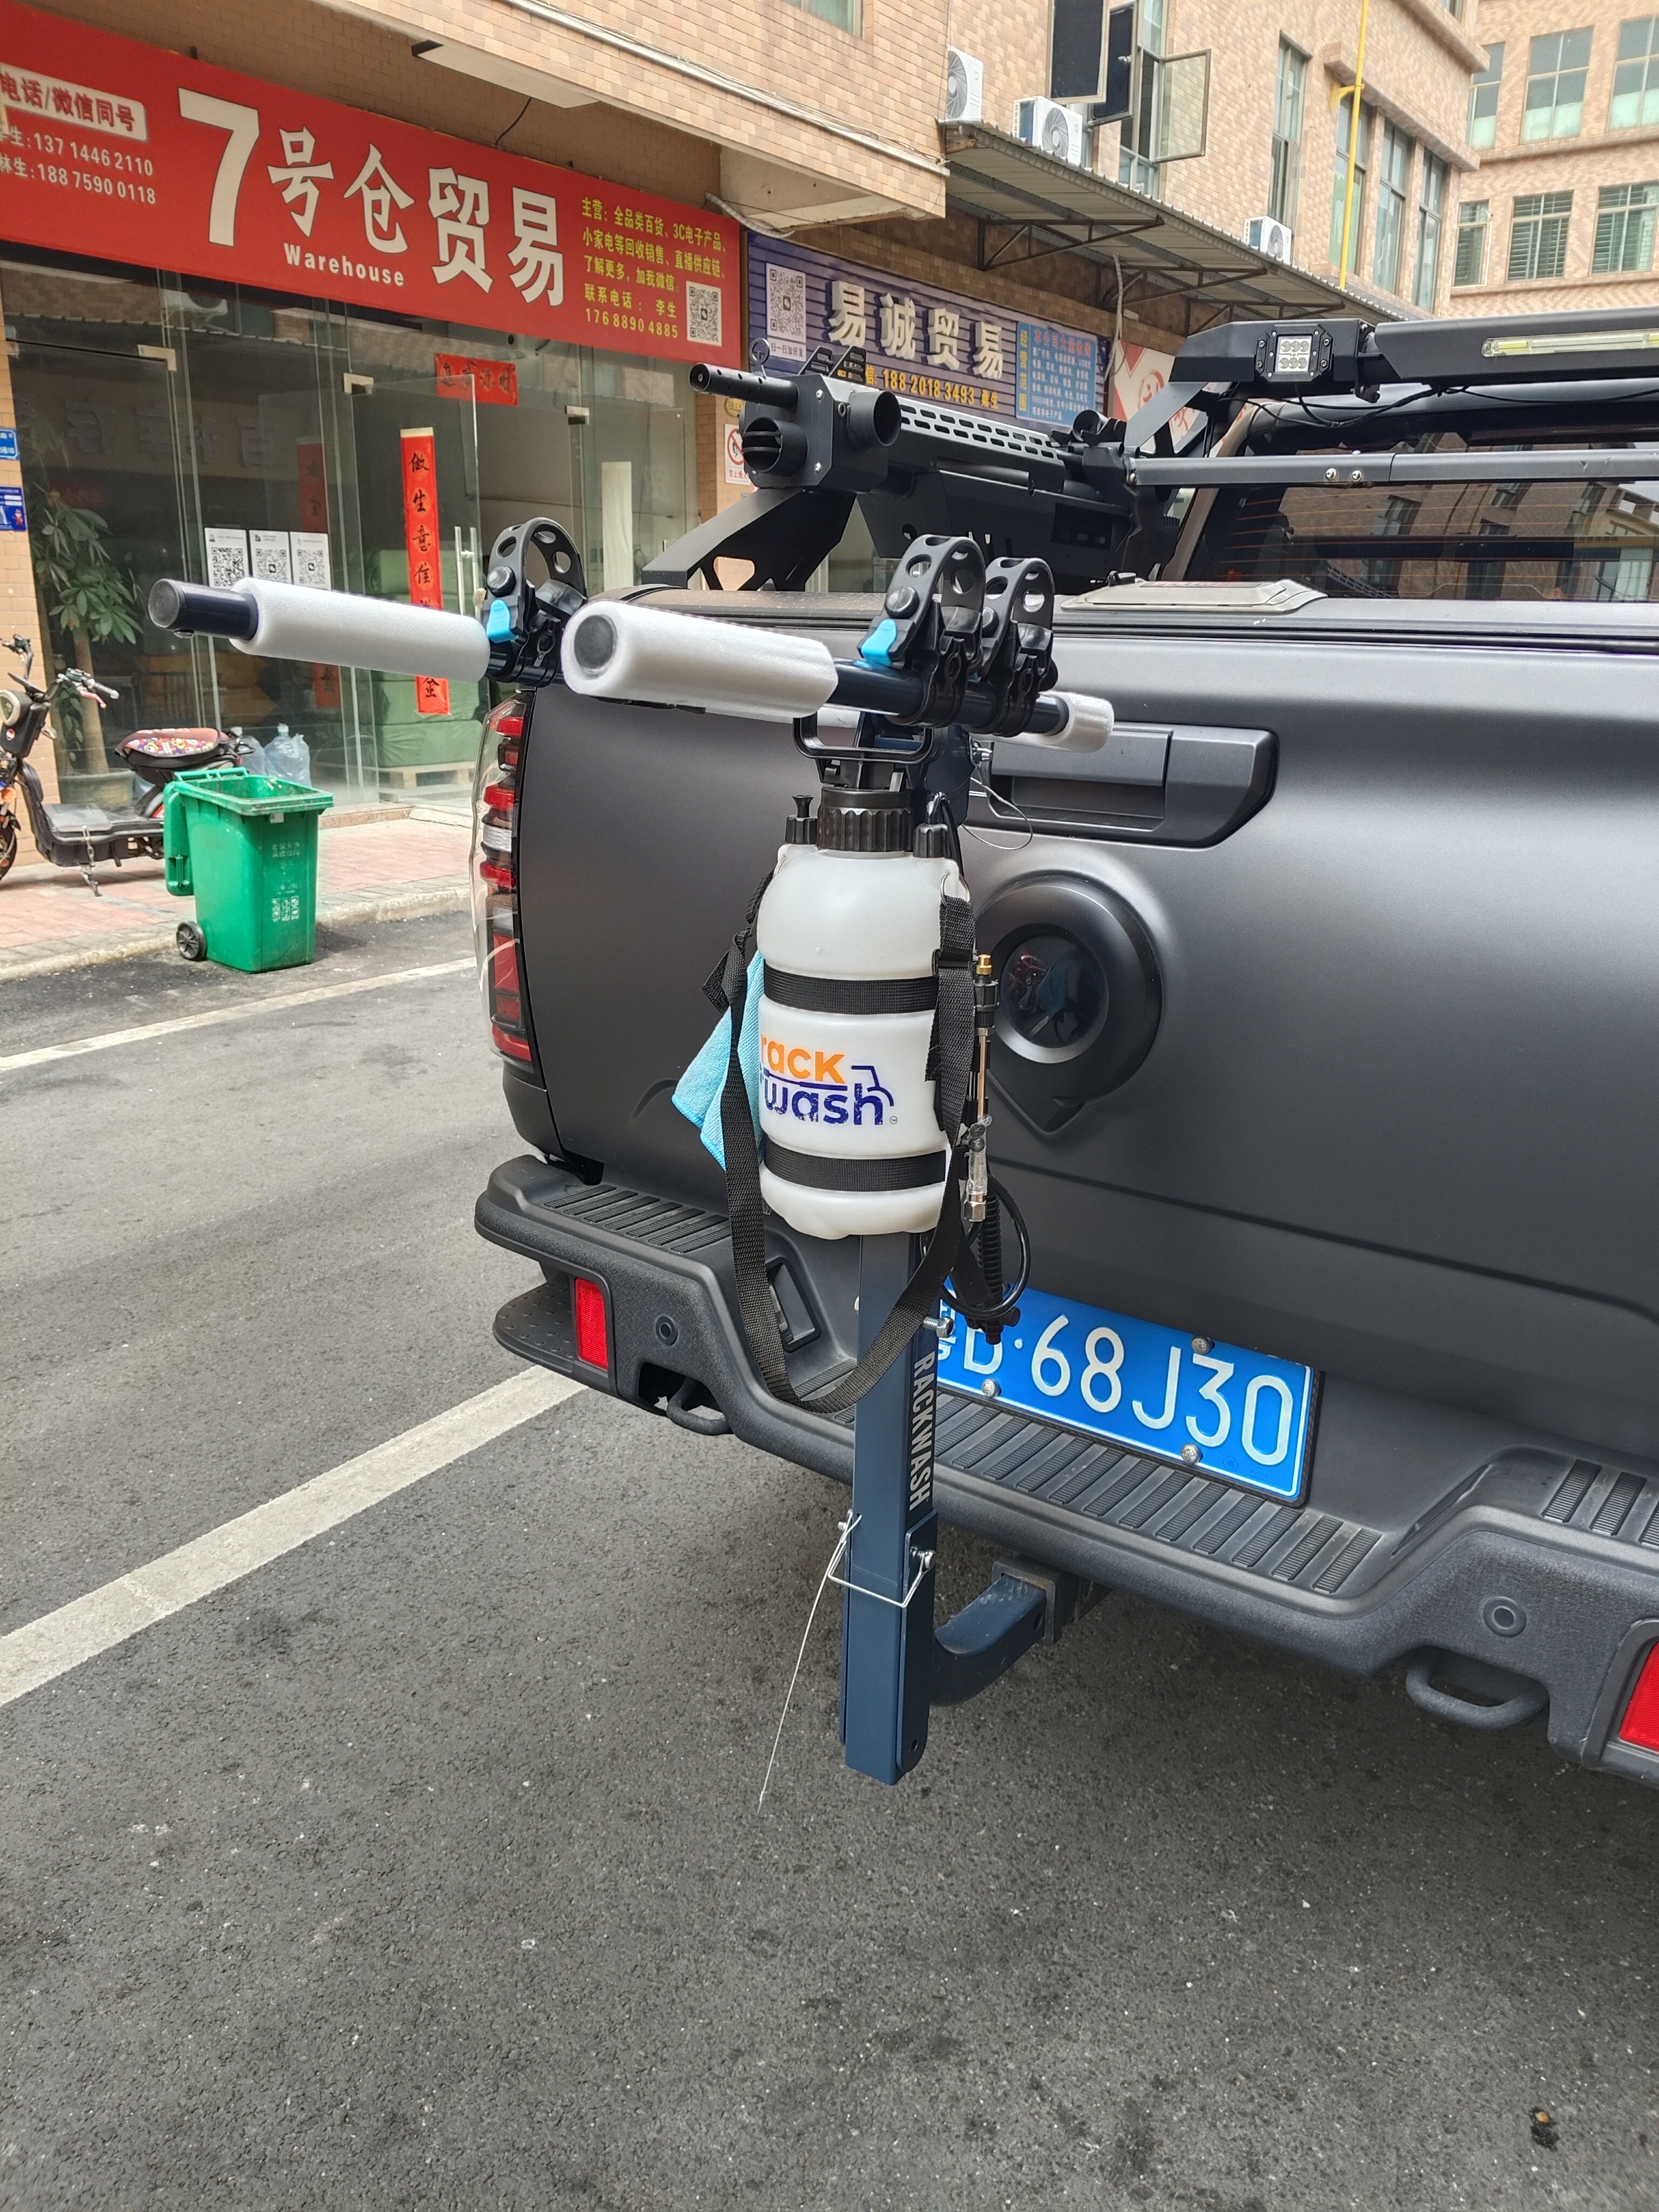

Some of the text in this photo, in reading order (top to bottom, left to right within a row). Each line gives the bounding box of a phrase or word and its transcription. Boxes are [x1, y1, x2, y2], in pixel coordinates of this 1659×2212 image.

[0, 72, 134, 132] 电话/微信同号
[70, 141, 110, 166] 1446
[114, 152, 153, 176] 2110
[72, 170, 113, 195] 7590
[117, 180, 156, 205] 0118
[283, 242, 405, 287] Warehouse
[585, 307, 678, 338] 176 8890 4885
[656, 299, 677, 319] 李生
[827, 280, 1004, 379] 易诚贸易
[883, 369, 907, 392] 188
[910, 374, 940, 399] 2018
[944, 382, 975, 406] 3493
[409, 451, 440, 698] 做生意信金
[764, 1083, 884, 1125] wash
[909, 1351, 936, 1512] RACKWASH
